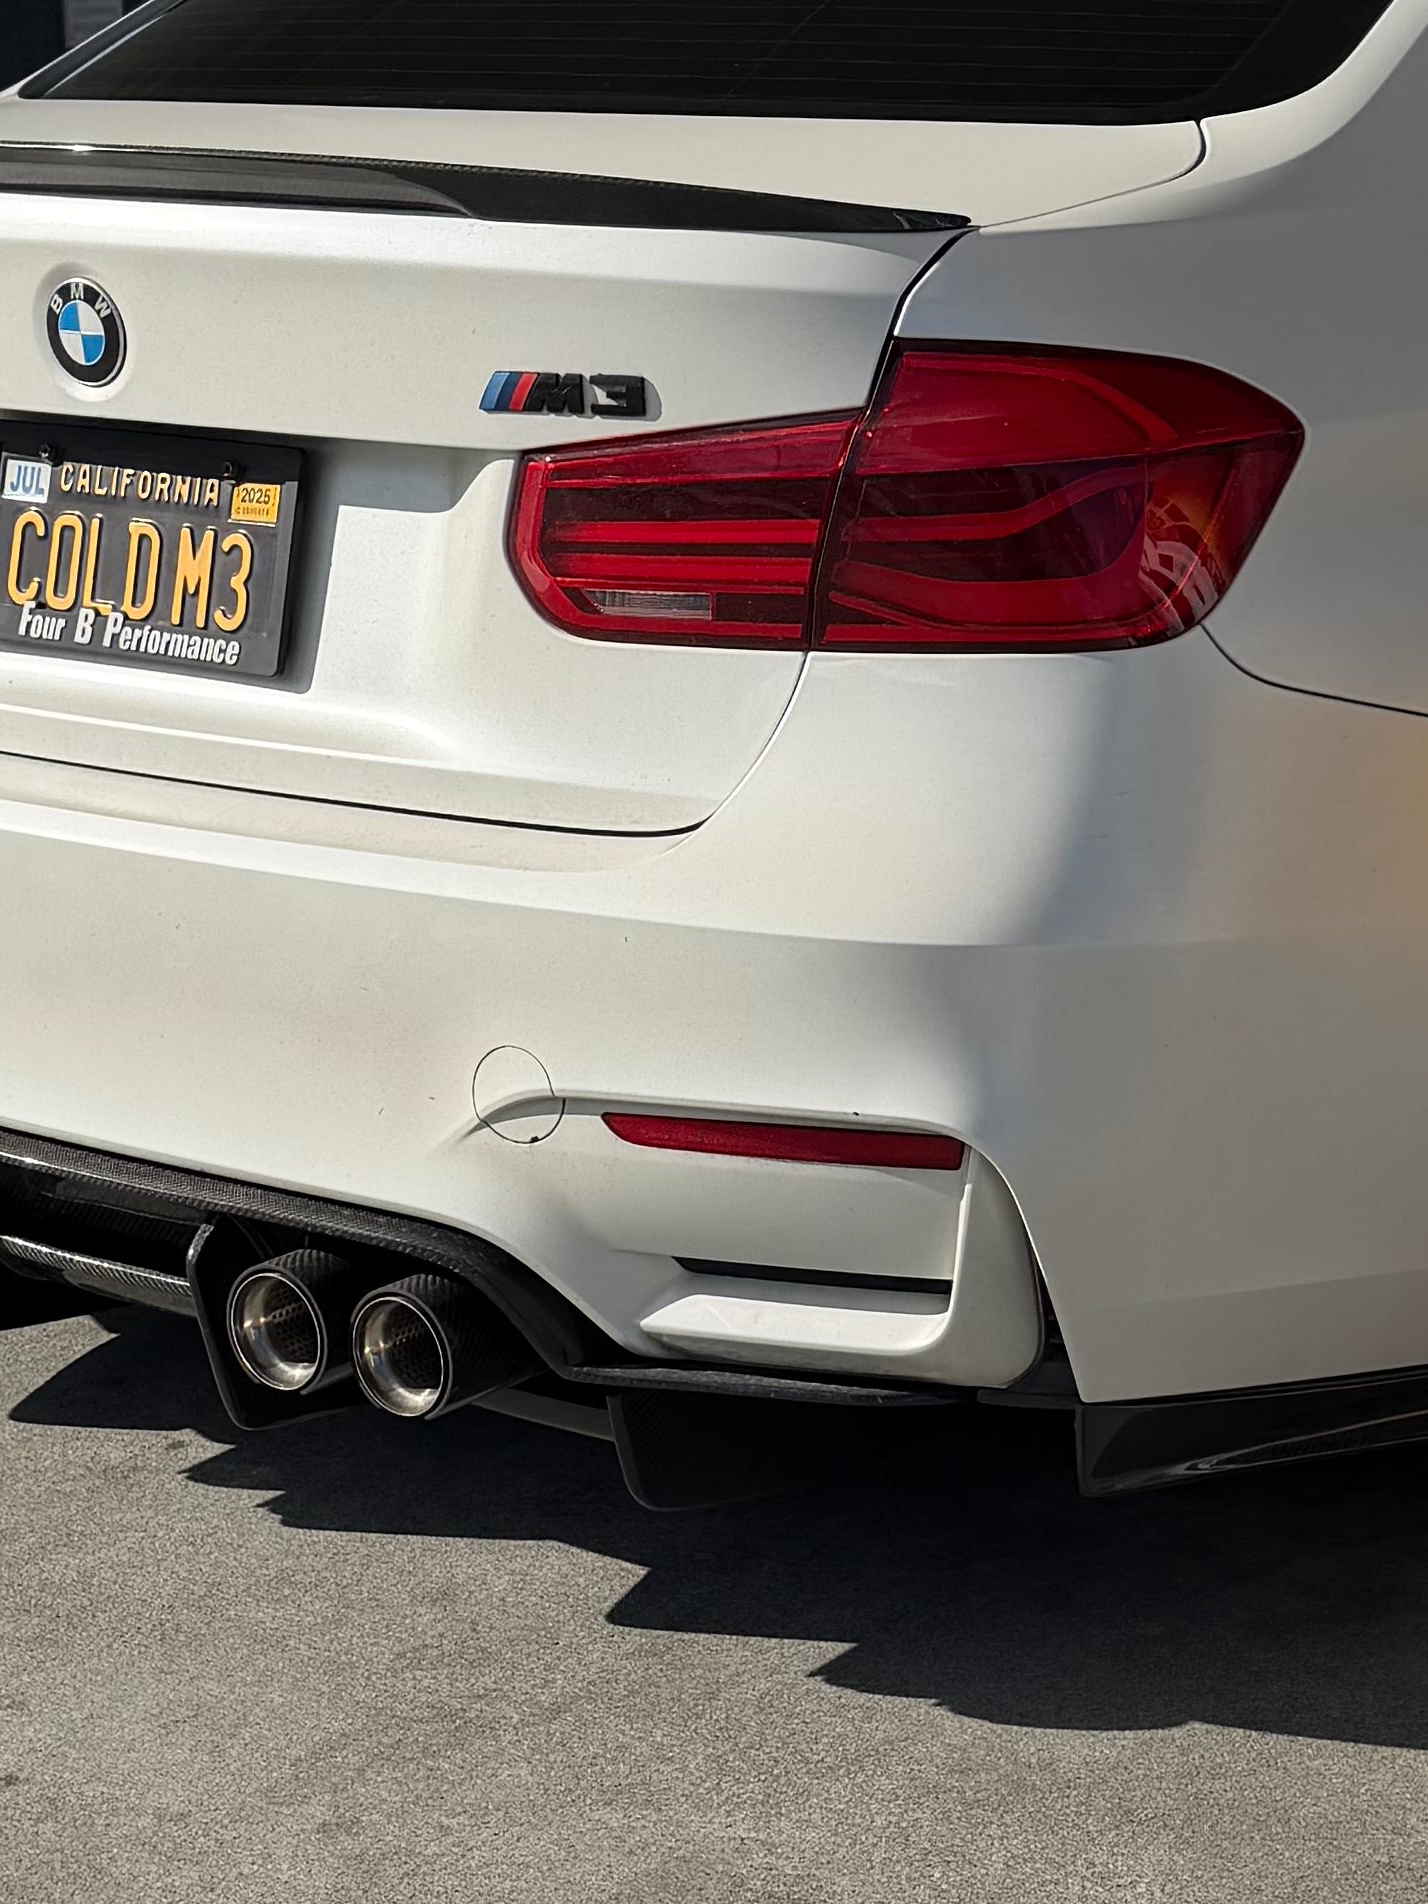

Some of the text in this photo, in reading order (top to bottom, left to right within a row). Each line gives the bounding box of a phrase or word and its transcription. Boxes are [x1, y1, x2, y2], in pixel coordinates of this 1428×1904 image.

[50, 282, 112, 318] BMW
[523, 372, 646, 417] M3
[9, 463, 46, 495] JUL
[59, 462, 221, 508] CALIFORNIA
[18, 603, 241, 666] Four B Performance
